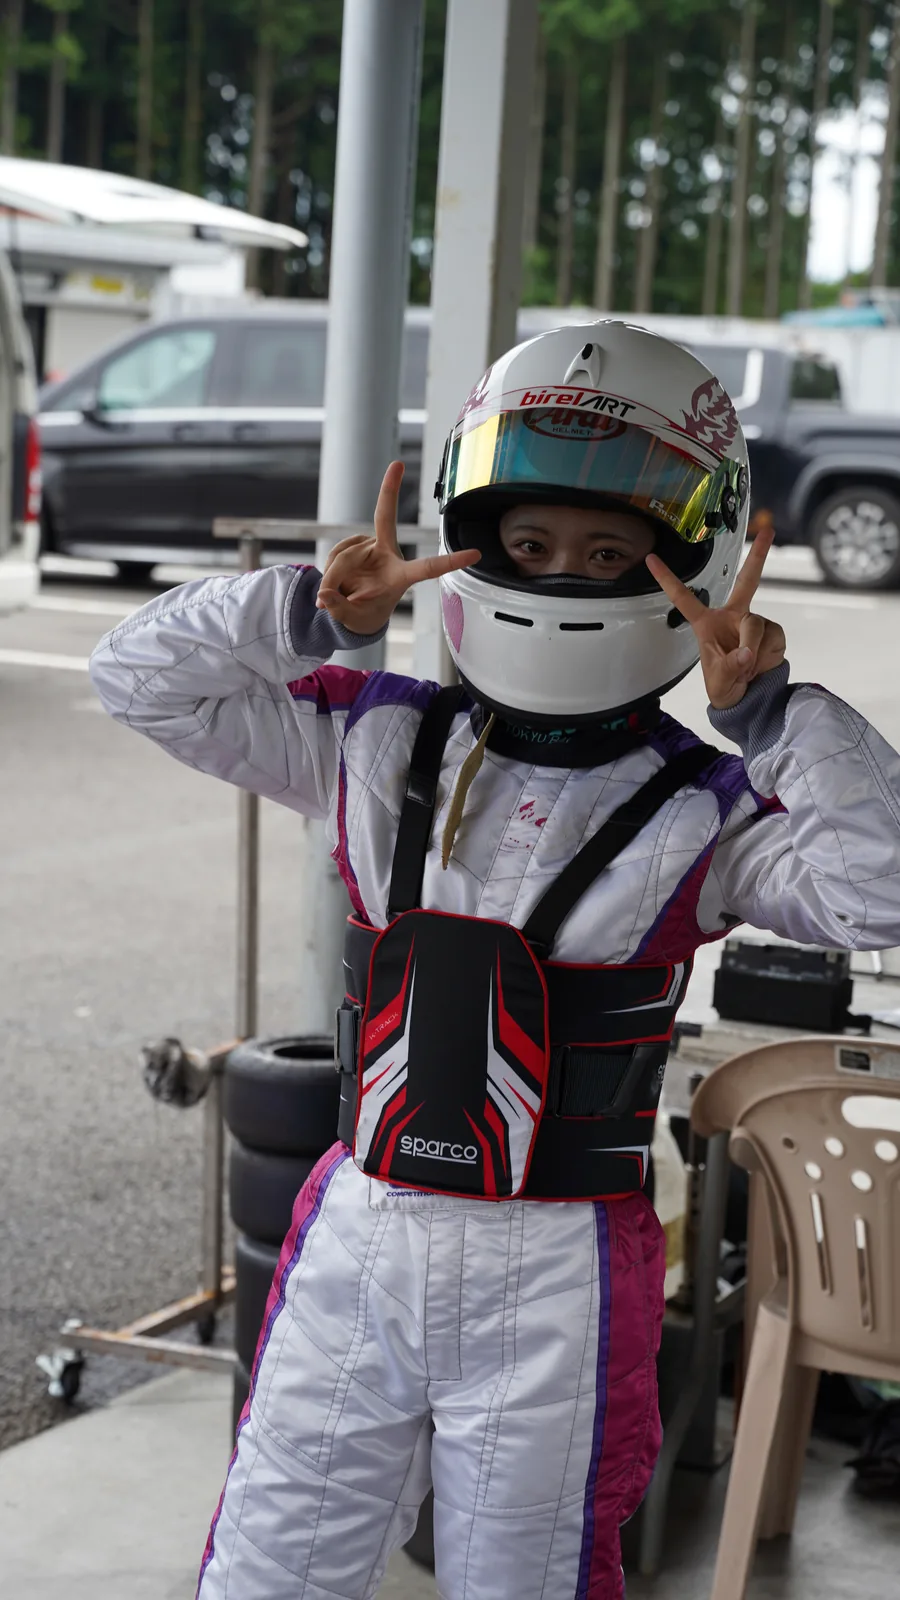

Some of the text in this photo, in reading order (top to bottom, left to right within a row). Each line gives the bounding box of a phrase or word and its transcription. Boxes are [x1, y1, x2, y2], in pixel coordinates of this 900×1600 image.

[551, 427, 592, 437] HELMET
[505, 720, 547, 743] TOKYU
[368, 1012, 399, 1041] K-TRACK
[400, 1134, 478, 1163] sparco
